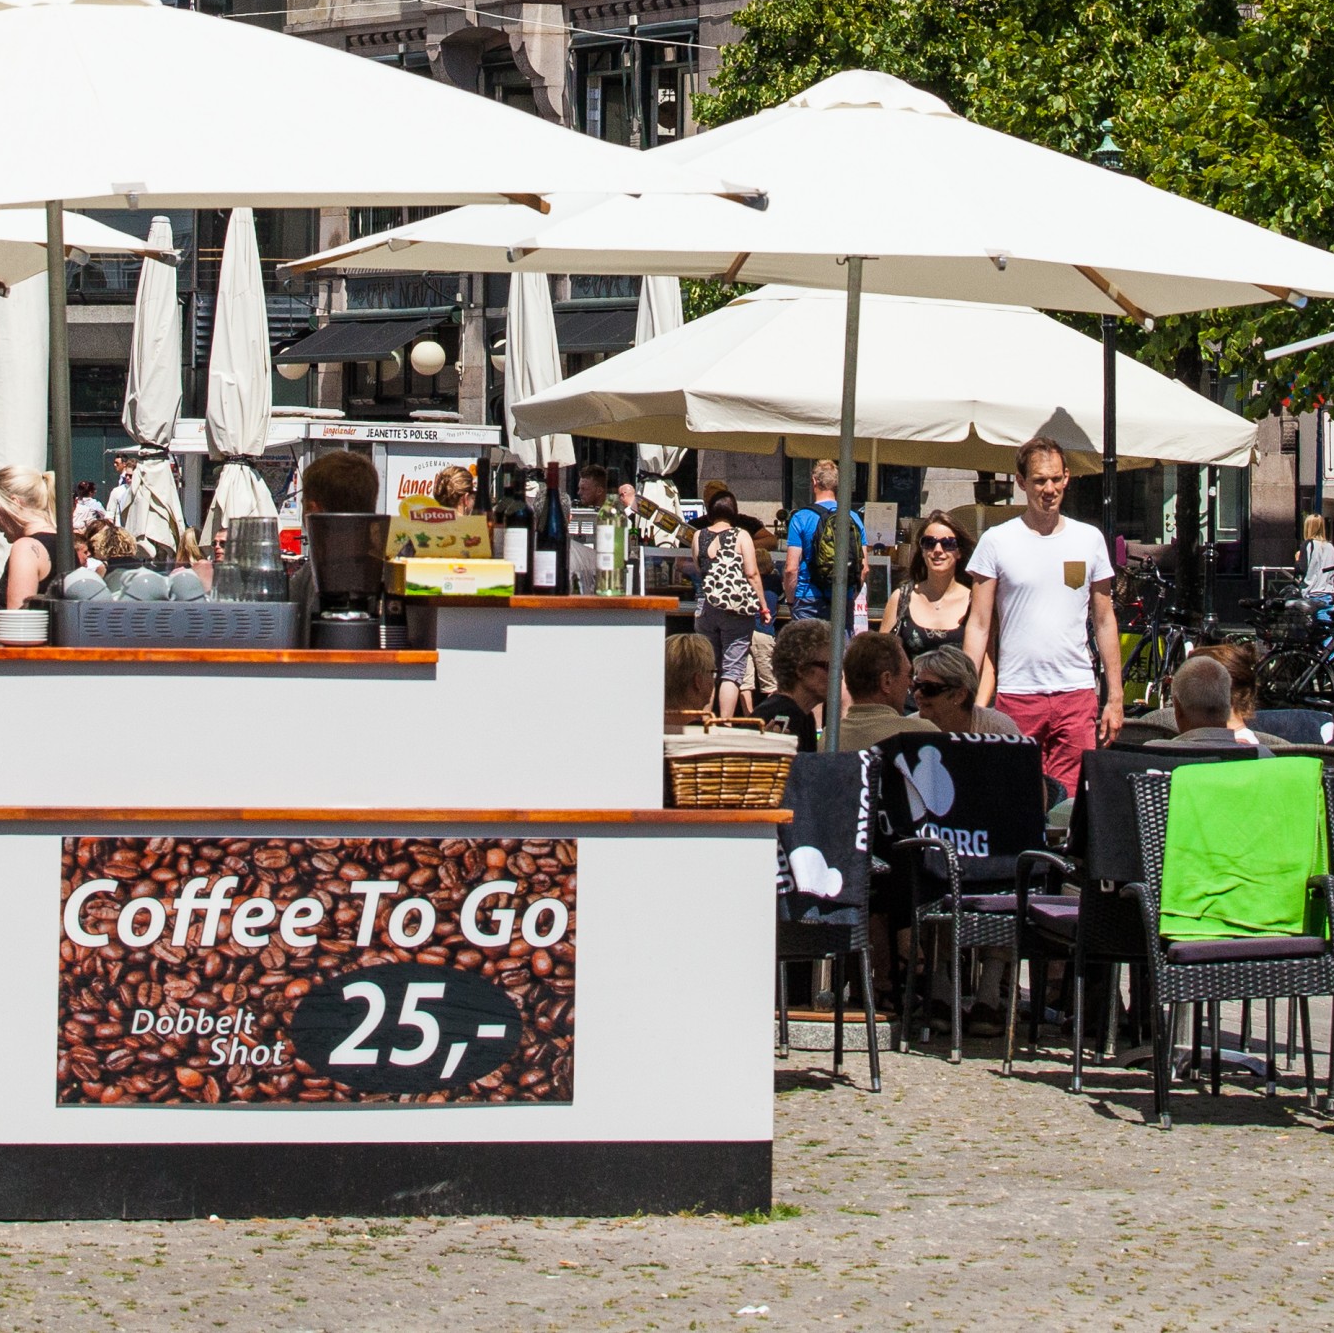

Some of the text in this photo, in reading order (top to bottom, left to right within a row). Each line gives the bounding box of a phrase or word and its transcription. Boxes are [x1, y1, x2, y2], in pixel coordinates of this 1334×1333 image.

[410, 429, 438, 440] PØLSER
[412, 510, 455, 521] Lipton
[63, 876, 569, 947] Coffee To Go
[131, 1008, 255, 1035] Dobbelt
[329, 982, 506, 1079] 25,-
[208, 1037, 286, 1066] Shot
